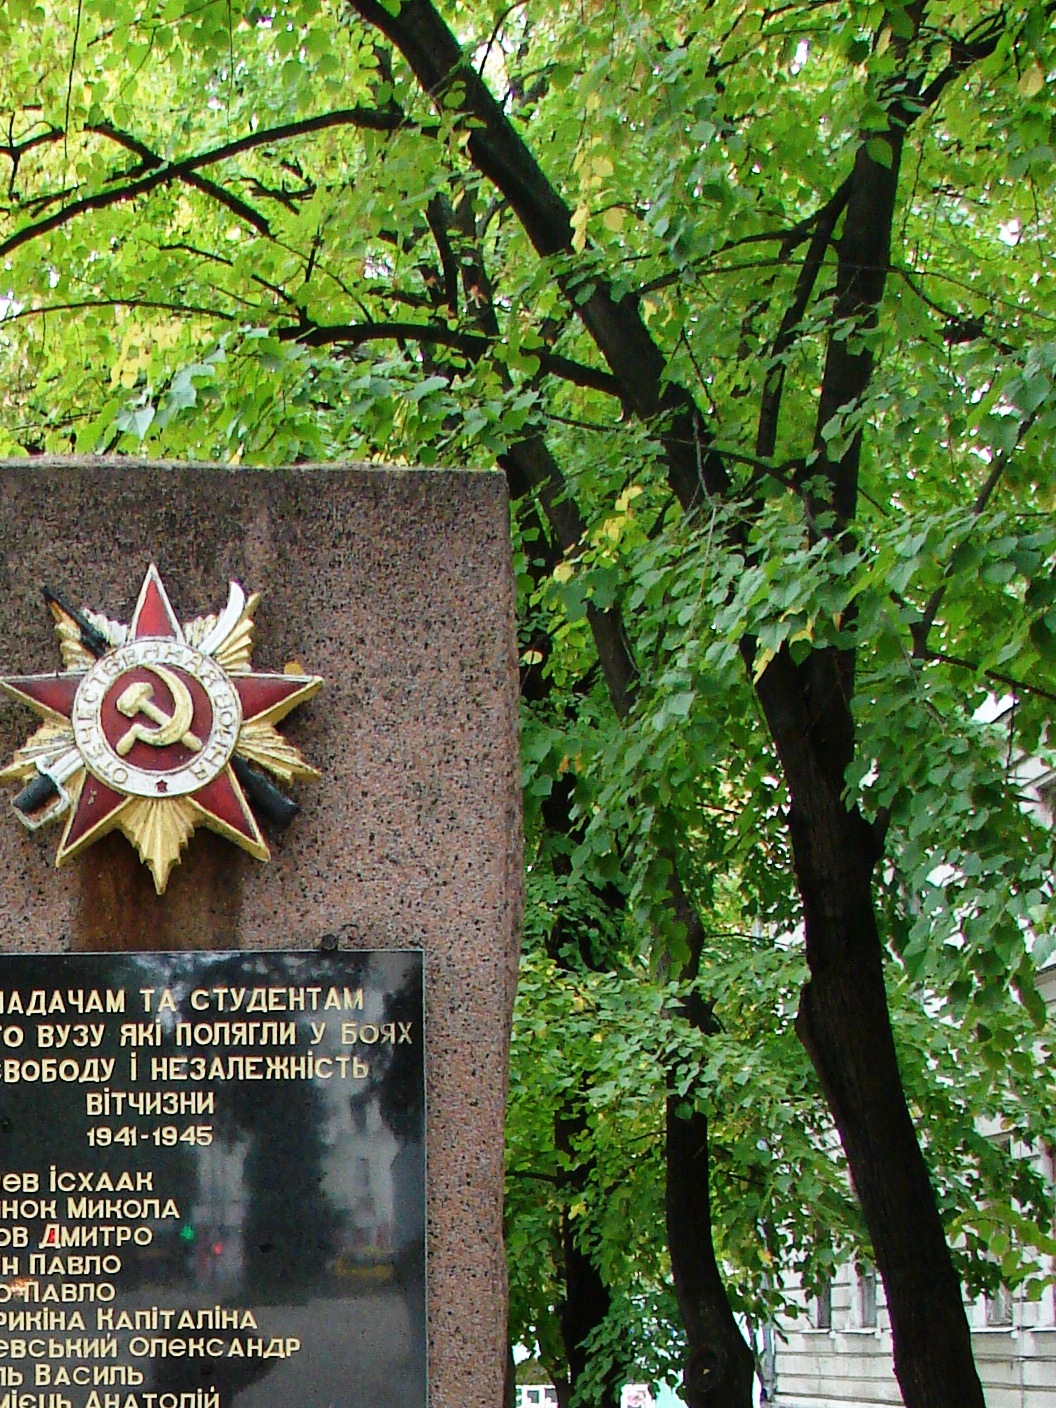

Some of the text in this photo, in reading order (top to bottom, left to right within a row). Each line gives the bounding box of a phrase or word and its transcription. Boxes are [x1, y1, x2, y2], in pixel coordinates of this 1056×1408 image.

[139, 988, 178, 1012] ТА
[190, 986, 364, 1013] СТУДЕНТАМ
[37, 1024, 105, 1048] ВУЗУ
[120, 1016, 162, 1047] ЯКІ
[176, 1021, 296, 1046] ПОЛЯГЛИ
[310, 1021, 327, 1045] У
[340, 1018, 412, 1045] БОЯХ
[130, 1051, 137, 1081] І
[151, 1050, 369, 1081] НЕЗАЛЕЖНІСТЬ
[86, 1087, 214, 1116] ВІТЧИЗНИ
[86, 1125, 213, 1147] 1941-1945
